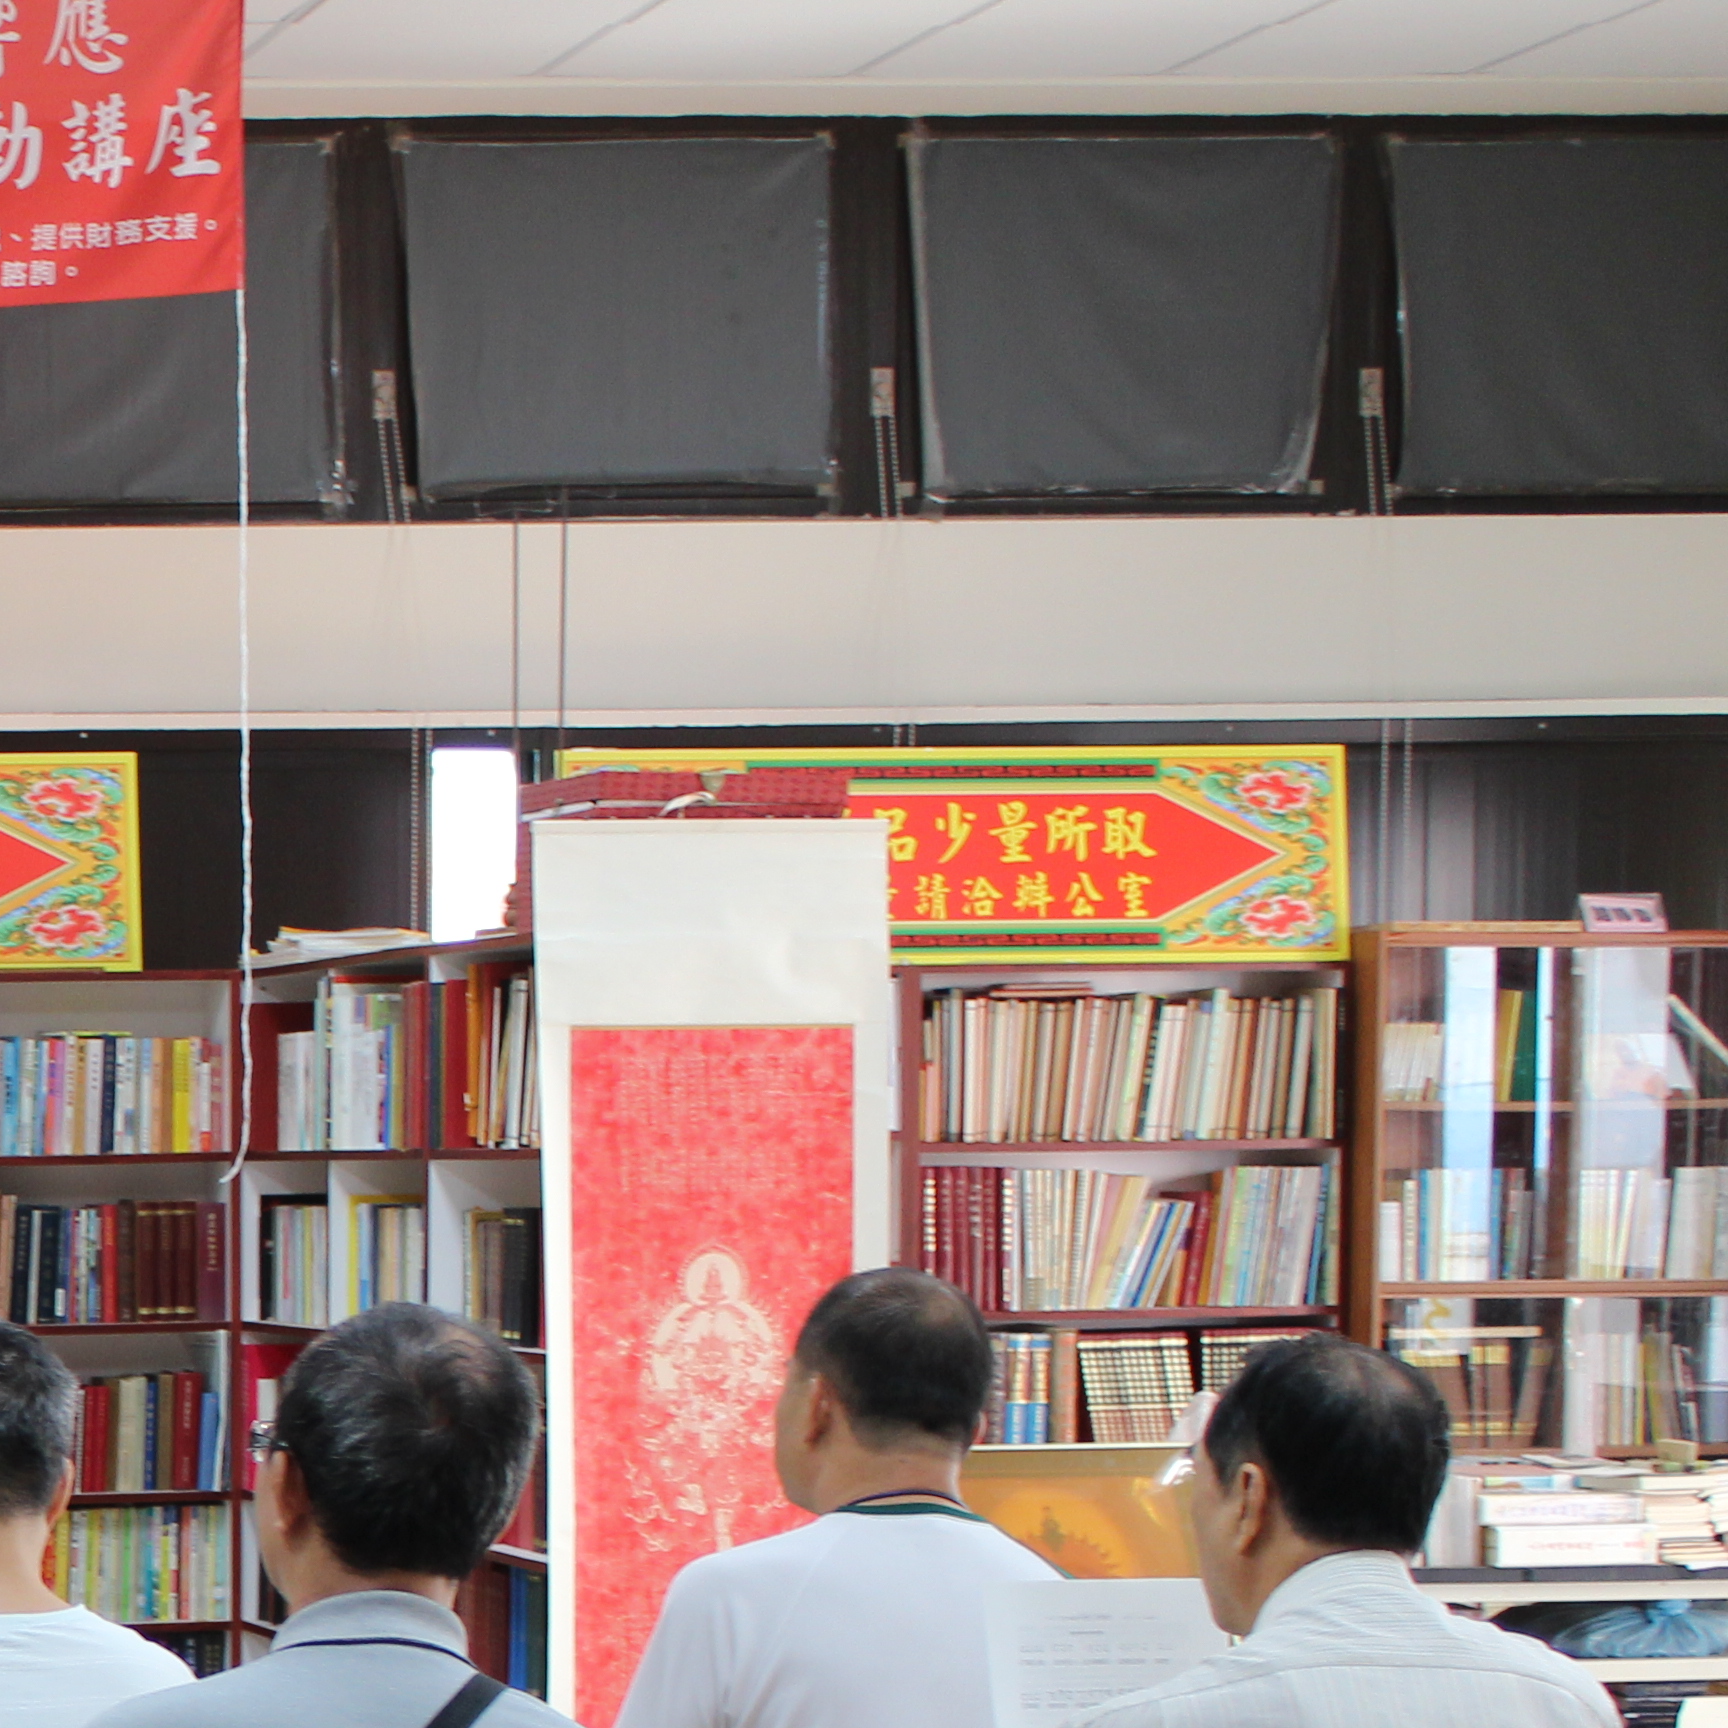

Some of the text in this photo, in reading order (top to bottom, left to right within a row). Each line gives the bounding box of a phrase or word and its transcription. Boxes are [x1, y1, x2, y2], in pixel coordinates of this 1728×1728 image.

[846, 800, 1158, 864] 品少量所取
[887, 870, 1154, 919] 請洽辦公室
